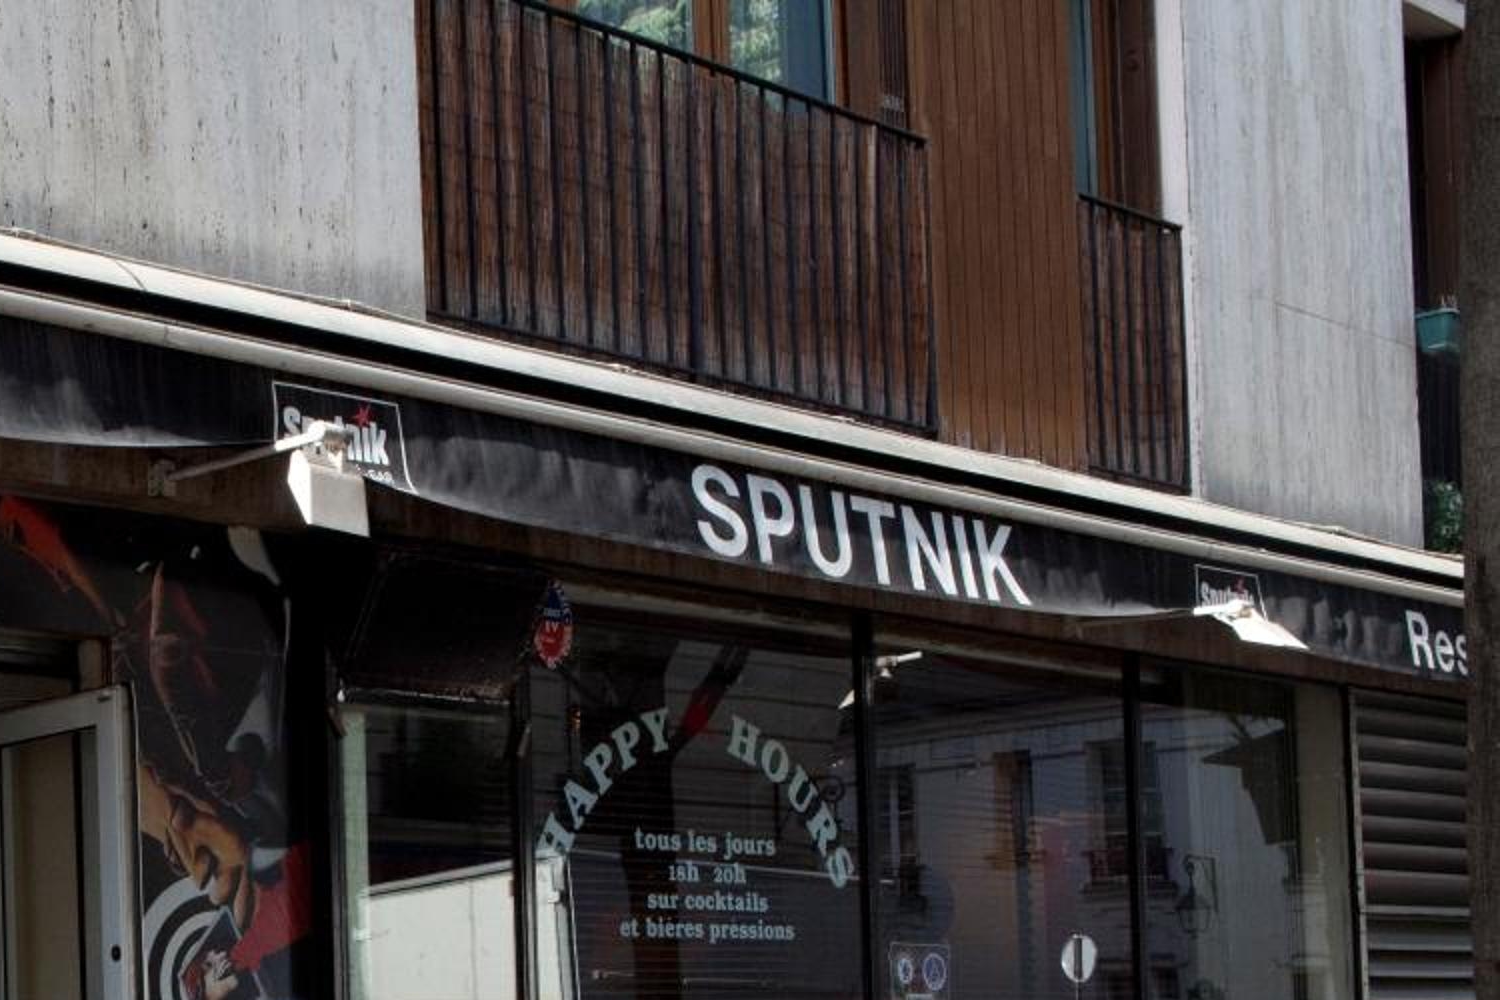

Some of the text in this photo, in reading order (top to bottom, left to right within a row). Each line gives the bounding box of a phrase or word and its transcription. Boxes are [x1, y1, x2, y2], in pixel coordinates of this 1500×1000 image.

[691, 463, 1033, 606] SPUTNIK
[534, 707, 855, 888] HAPPY HOURS
[633, 826, 777, 860] tous les jours
[668, 860, 747, 885] 18h 20h
[646, 890, 770, 913] sur cocktails
[619, 918, 641, 938] et
[709, 919, 797, 944] pressions
